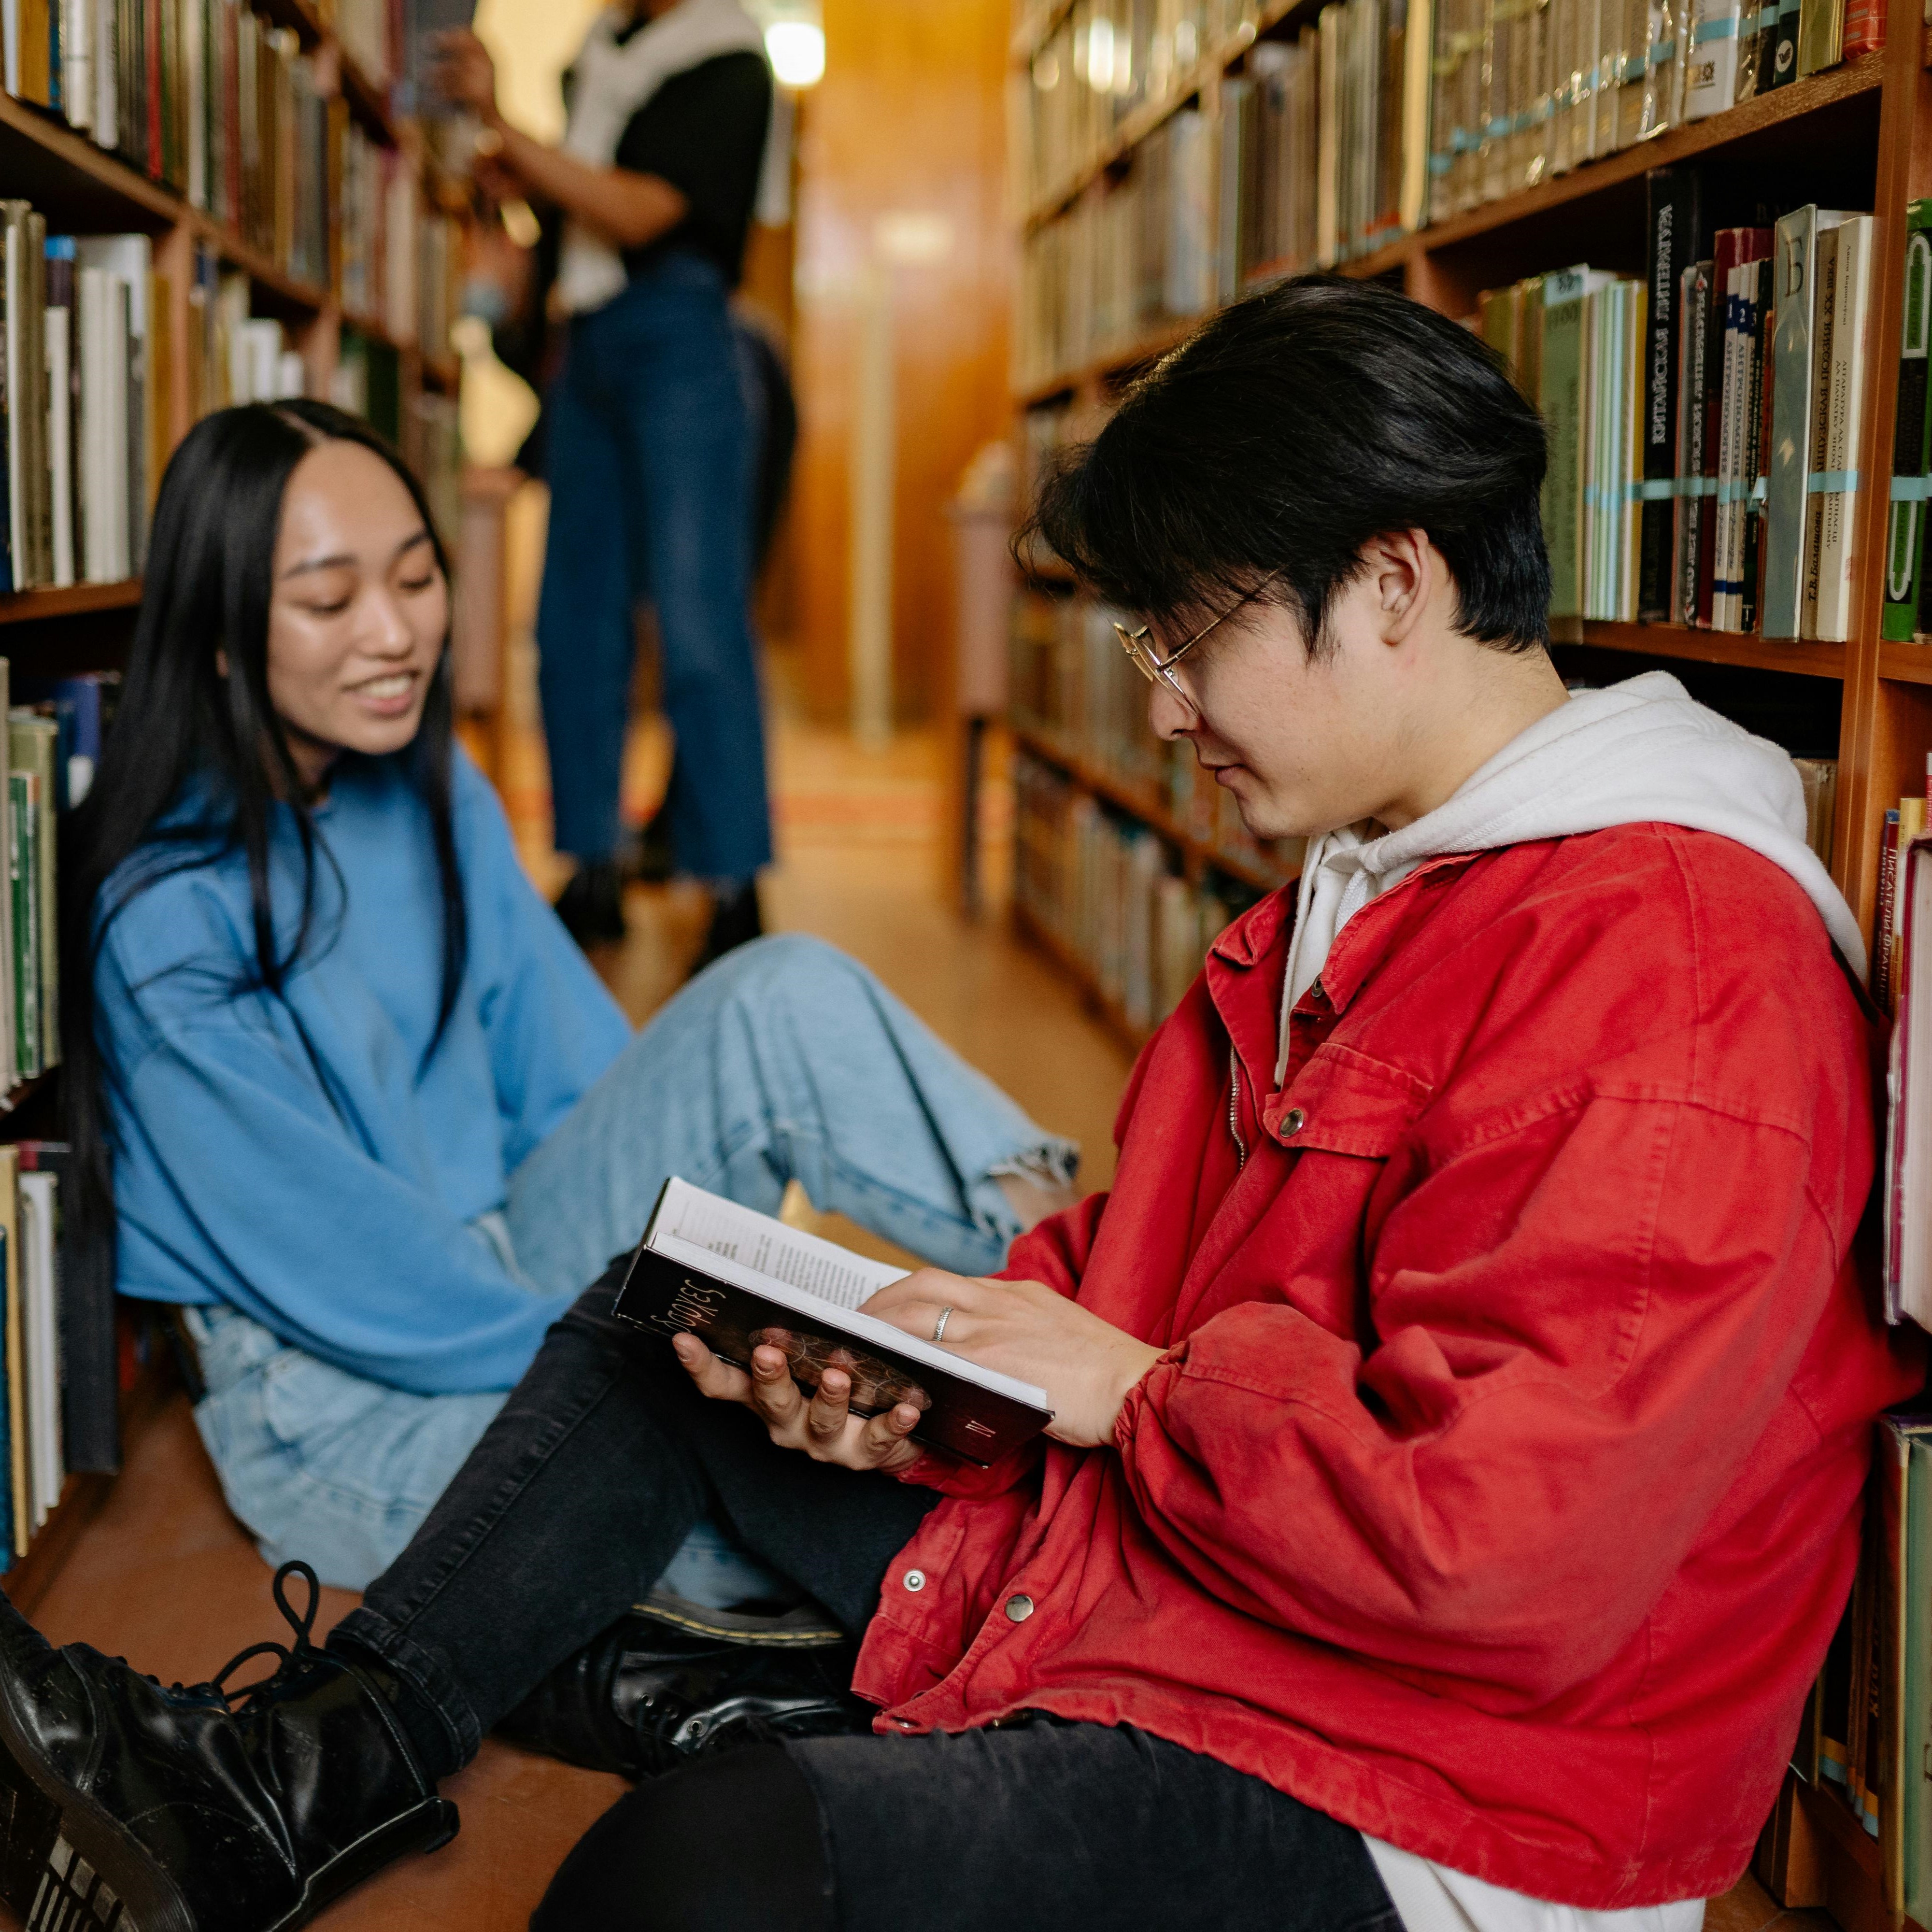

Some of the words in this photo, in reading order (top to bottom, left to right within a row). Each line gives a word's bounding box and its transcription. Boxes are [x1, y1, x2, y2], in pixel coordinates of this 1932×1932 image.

[1655, 204, 1673, 321] ЛИТЕРАТУРА
[1651, 328, 1669, 444] КИТАЙСКАЯ
[1821, 322, 1831, 381] ПОЭЗИЯ
[1835, 360, 1840, 375] ДА
[1721, 340, 1733, 473] АНТРОПОЛОГИЯ
[1733, 343, 1745, 477] АНТРОПОЛОГИЯ
[1817, 388, 1828, 472] НЦУЗСКАЯ
[1838, 428, 1844, 443] АД
[1810, 511, 1821, 576] Балашова
[1884, 848, 1898, 930] ПИСАТЕЛИ
